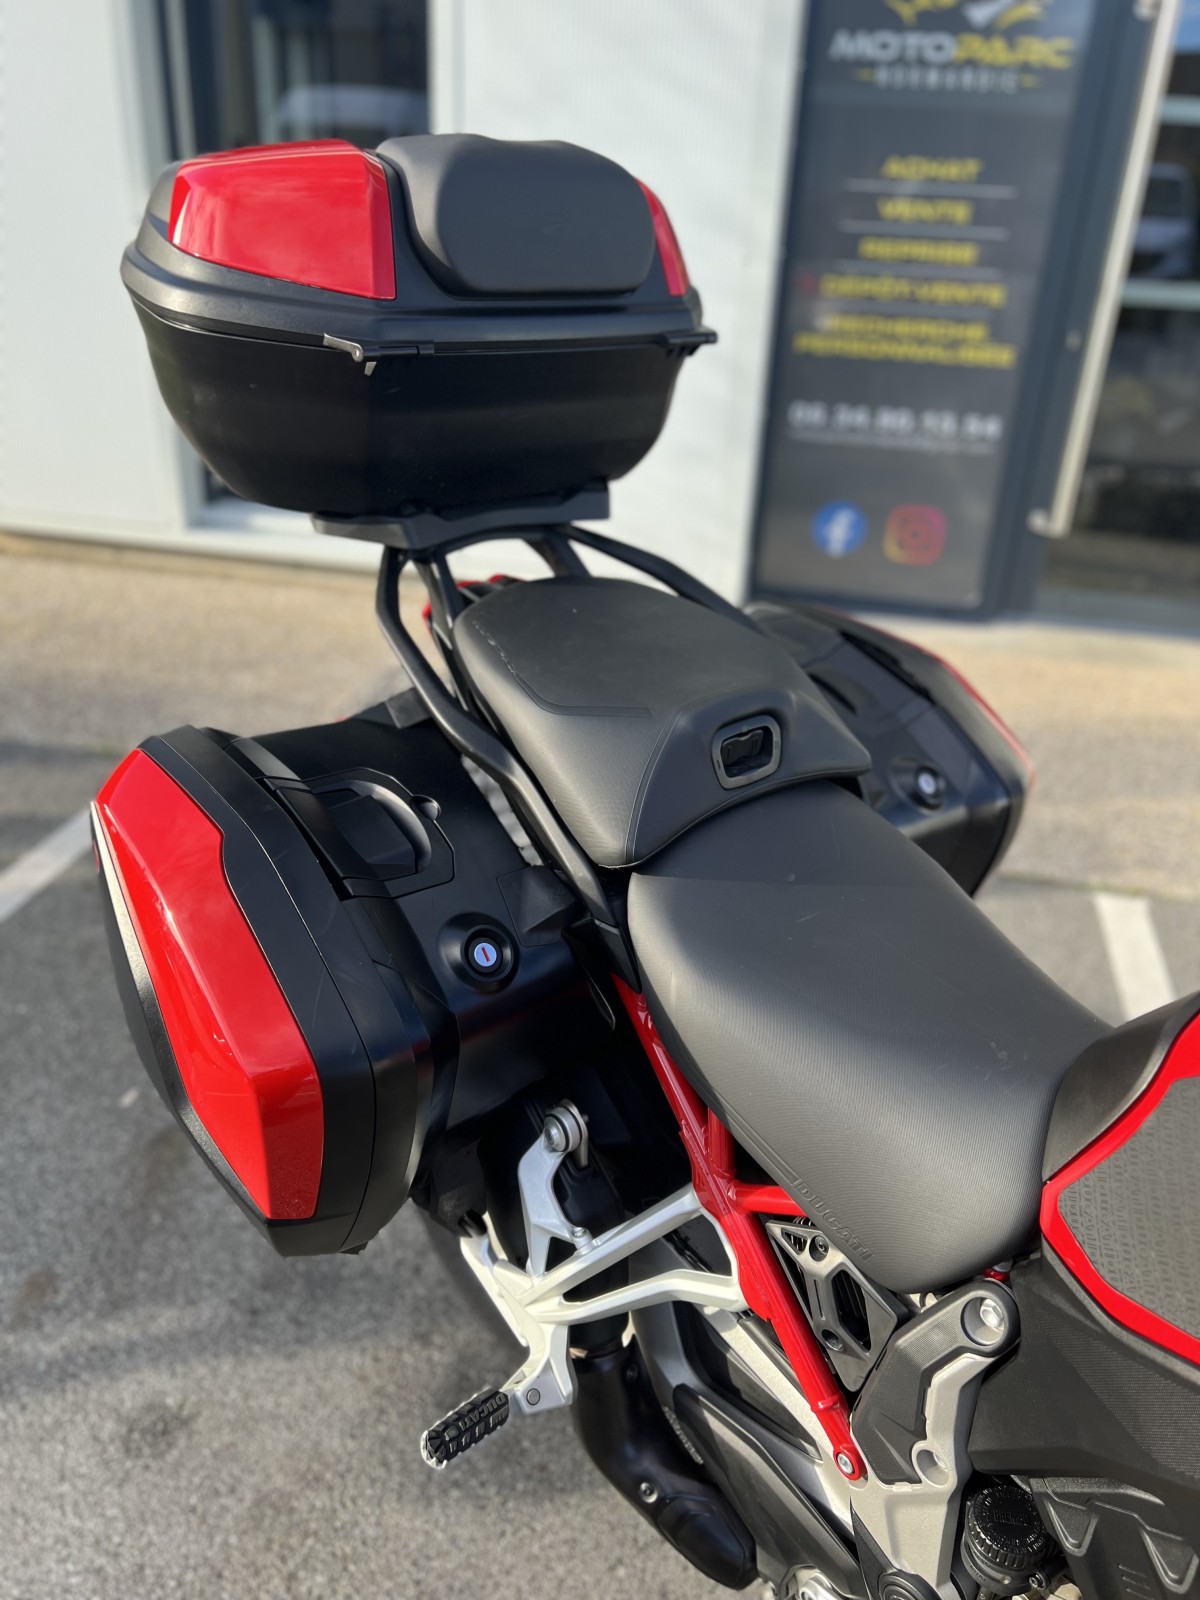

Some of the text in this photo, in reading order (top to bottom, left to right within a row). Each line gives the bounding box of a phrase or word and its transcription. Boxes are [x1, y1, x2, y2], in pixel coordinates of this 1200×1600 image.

[877, 198, 974, 224] VENTE
[796, 1181, 875, 1262] DUCATI
[458, 1393, 508, 1431] DUCATI
